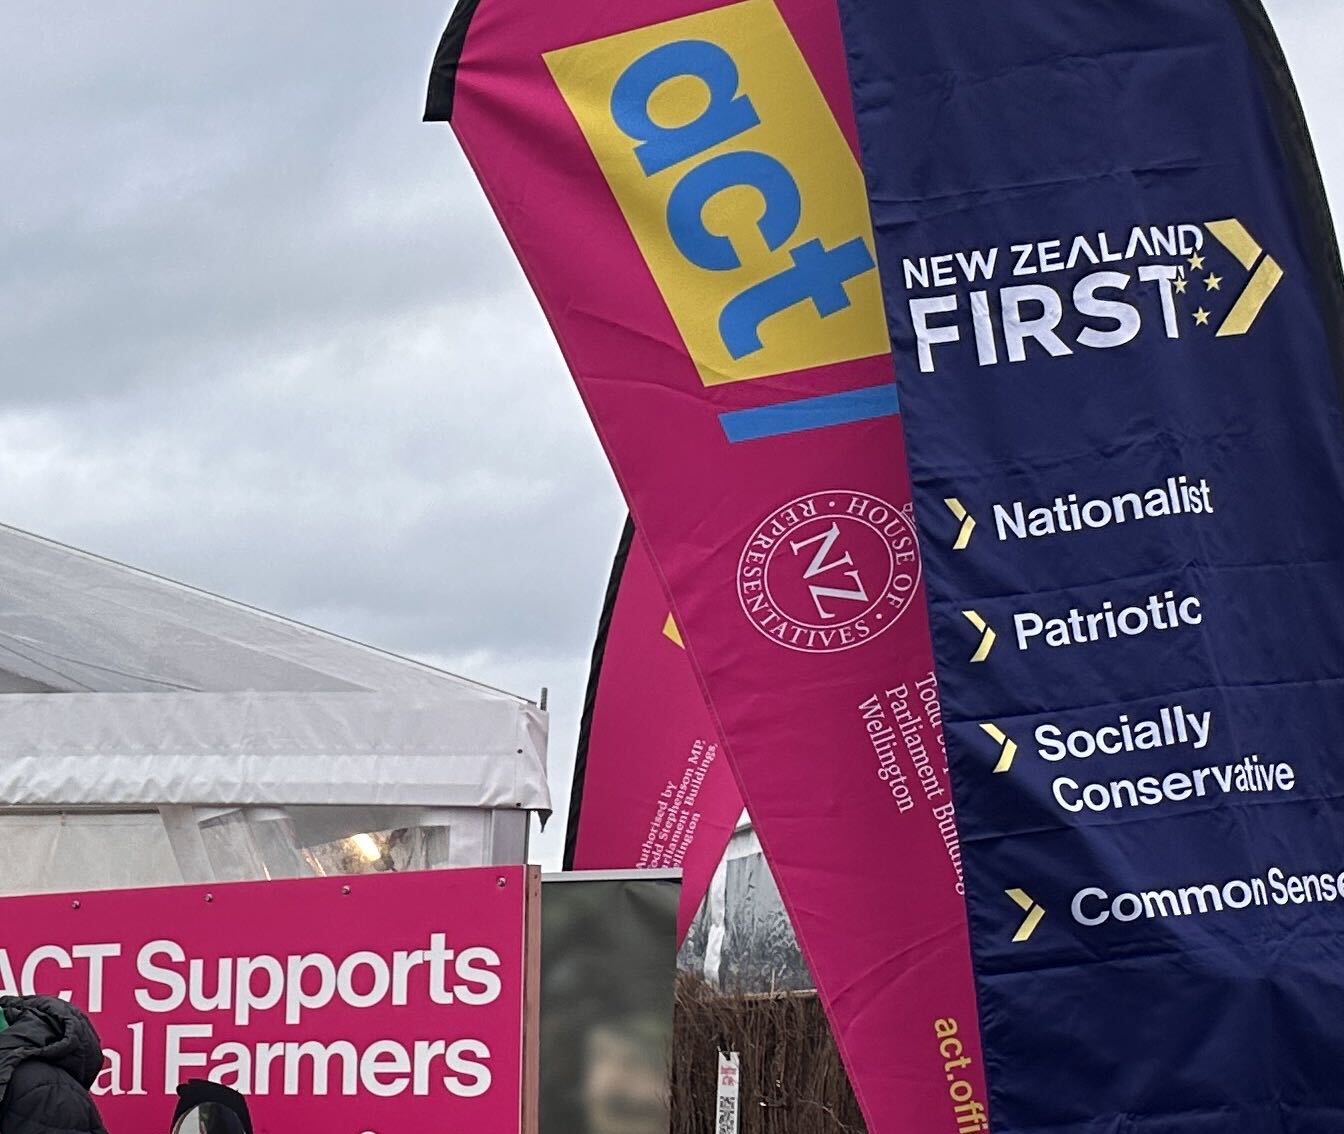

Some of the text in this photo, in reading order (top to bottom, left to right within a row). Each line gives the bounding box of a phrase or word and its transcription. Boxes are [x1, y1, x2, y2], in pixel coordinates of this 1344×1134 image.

[611, 39, 877, 361] act
[903, 224, 1204, 289] NEW ZEALAND
[909, 264, 1185, 372] FIRST
[995, 478, 1214, 543] Nationalist
[743, 497, 915, 647] HOUSE OF REPRESENTATIVES
[789, 521, 869, 619] NZ
[1013, 590, 1202, 650] Patriotic
[858, 693, 914, 814] Wellington
[885, 682, 945, 800] Parliament
[1034, 705, 1211, 761] Socially
[659, 767, 694, 842] Stephenson
[660, 780, 678, 798] by
[1052, 755, 1295, 813] Conservative
[1071, 876, 1268, 926] Common
[134, 932, 502, 1026] Supports
[165, 1023, 492, 1099] Farmers
